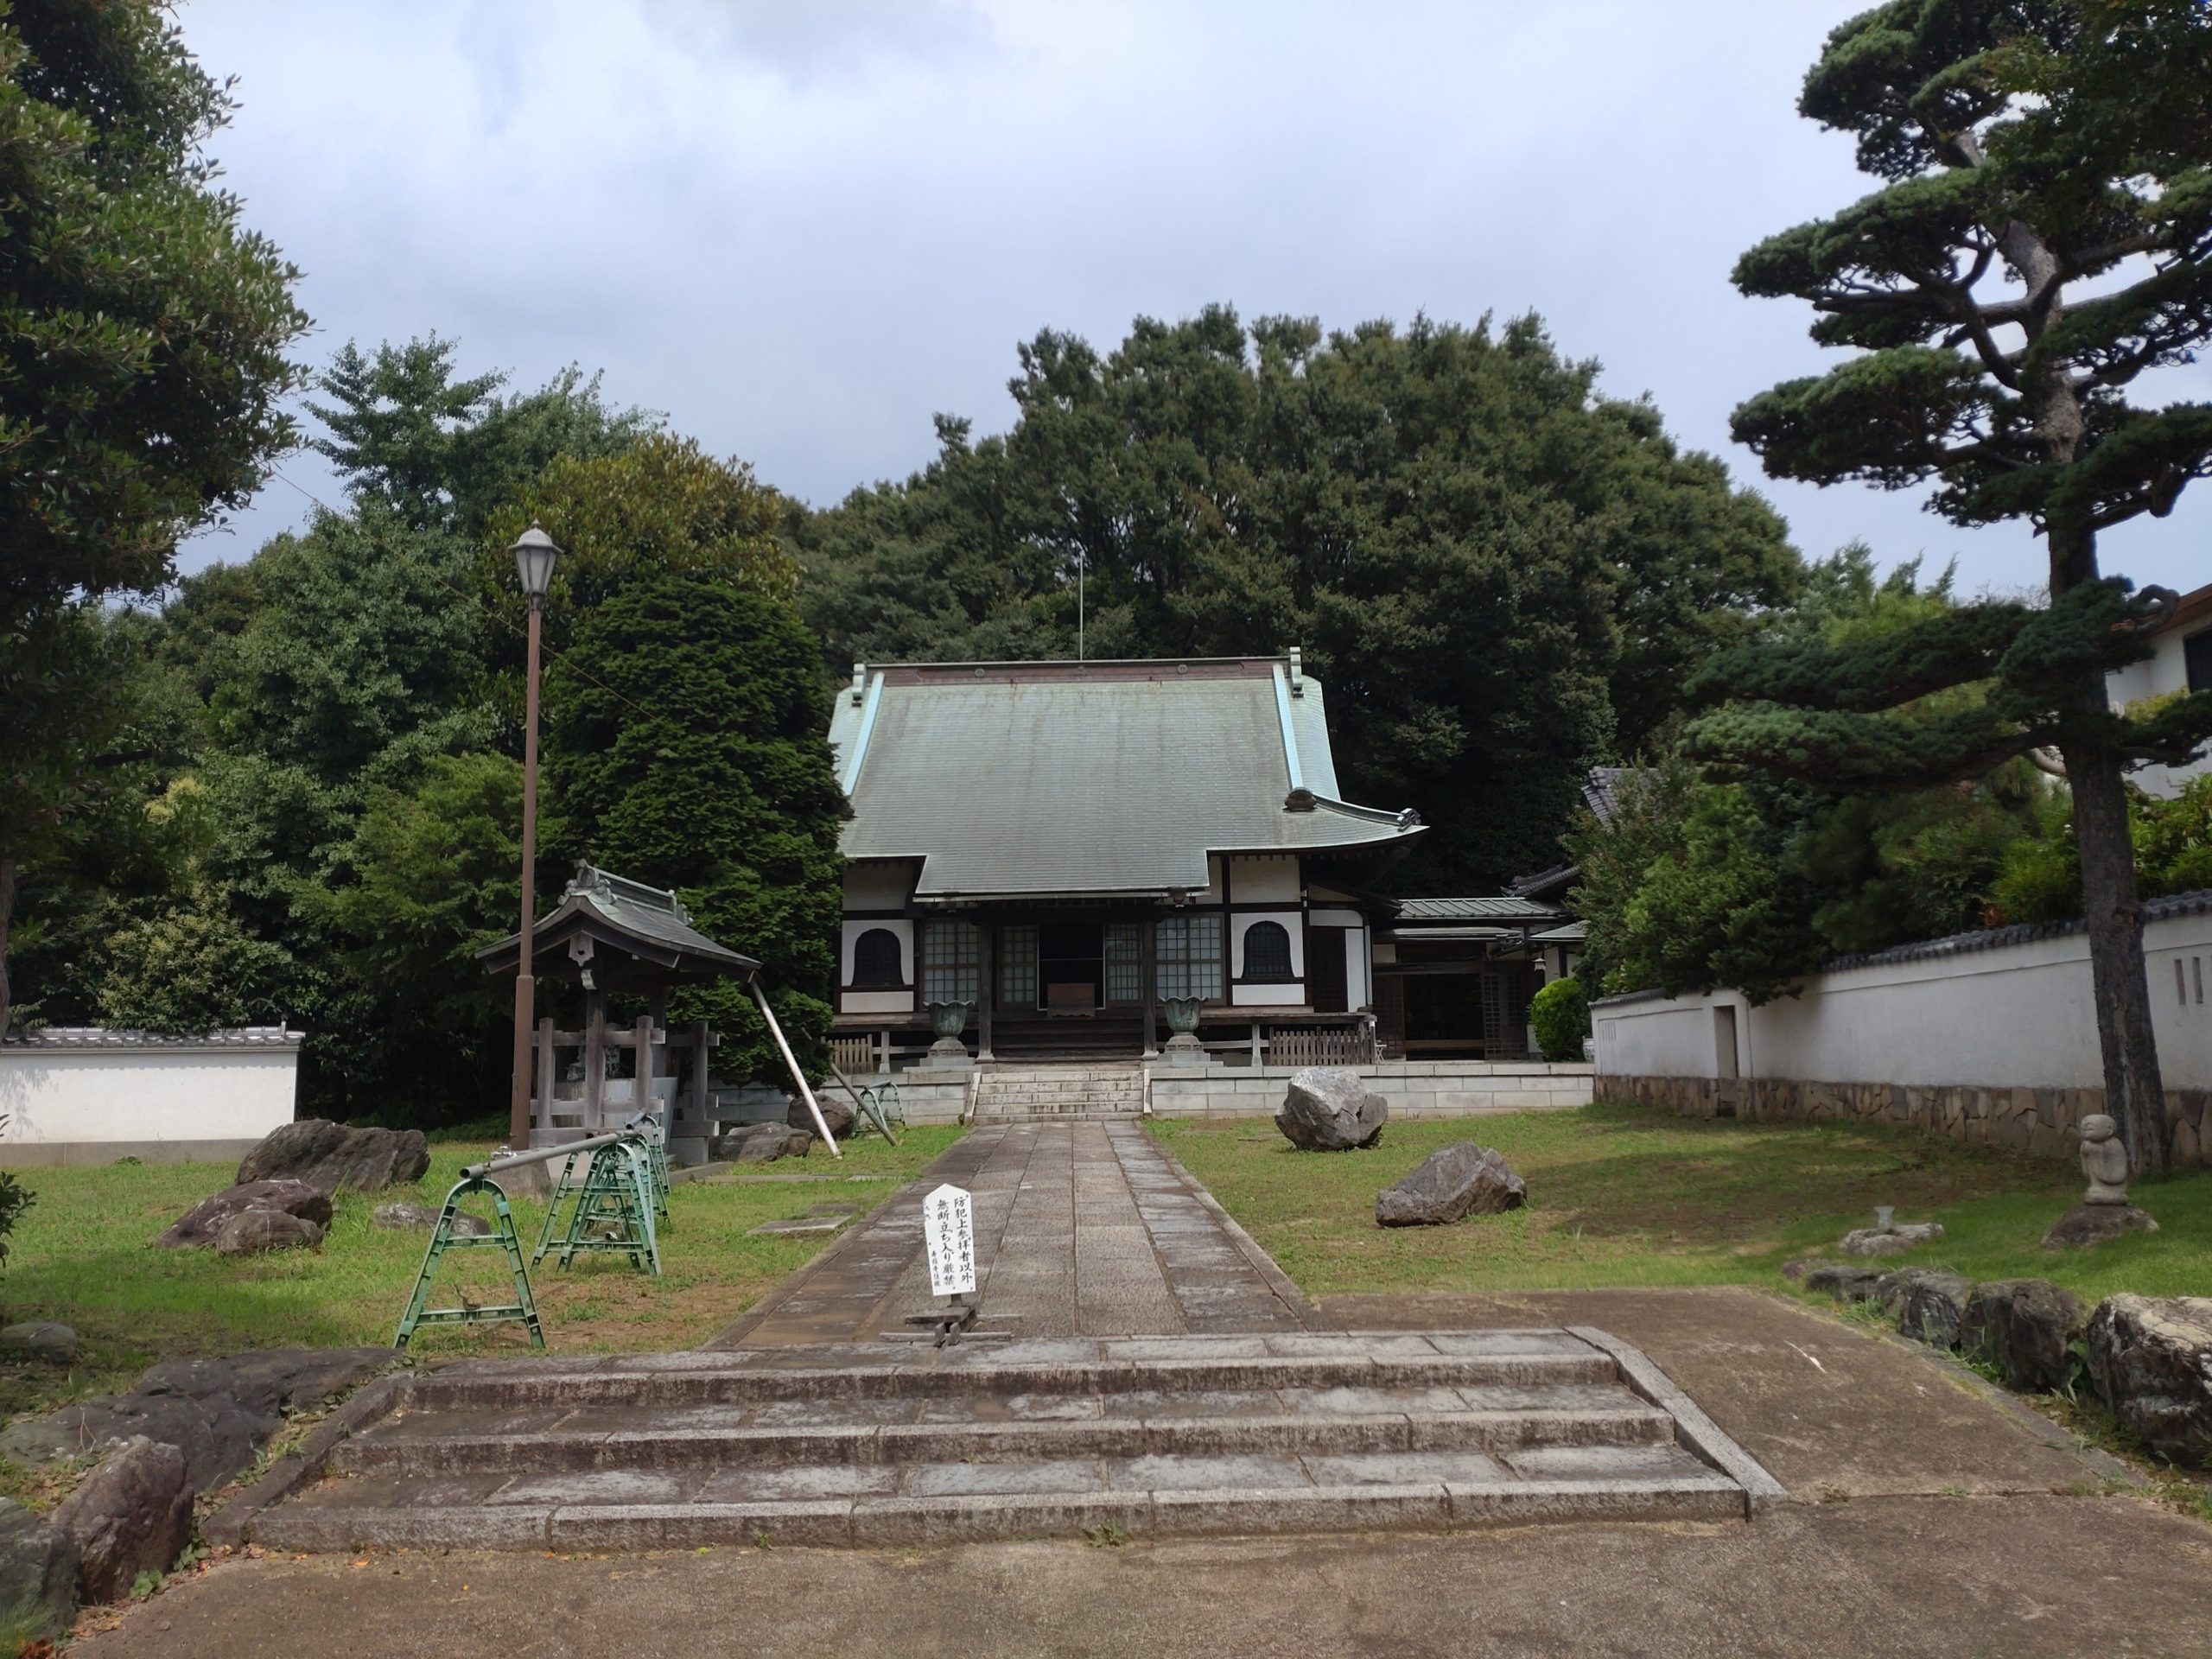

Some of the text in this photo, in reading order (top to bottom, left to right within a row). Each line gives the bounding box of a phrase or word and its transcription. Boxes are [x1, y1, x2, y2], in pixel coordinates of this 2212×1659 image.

[937, 1198, 955, 1286] 無断立ち入り厳禁
[954, 1197, 973, 1283] 防犯上参拝者以外
